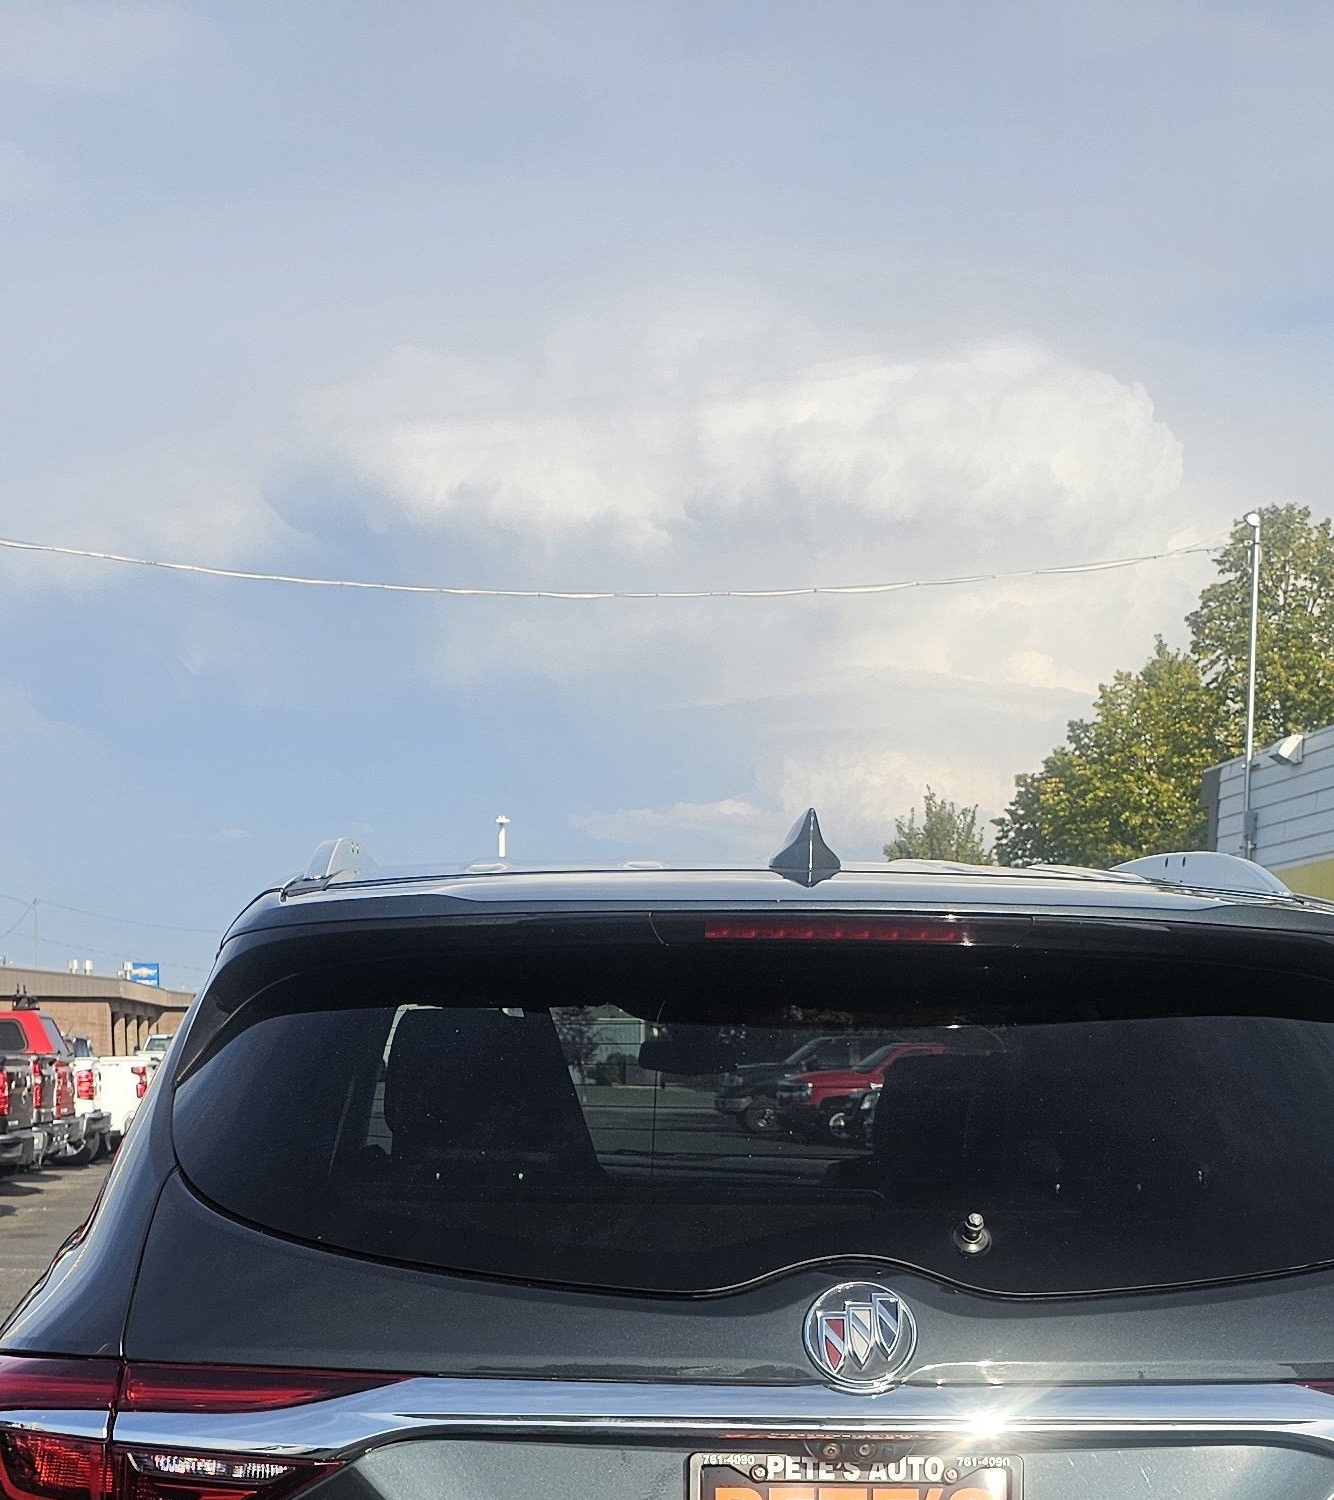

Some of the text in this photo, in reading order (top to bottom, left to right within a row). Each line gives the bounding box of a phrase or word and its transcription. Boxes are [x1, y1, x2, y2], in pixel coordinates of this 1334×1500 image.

[702, 1454, 756, 1466] 761-4090
[956, 1456, 1010, 1467] 761-4090
[767, 1455, 945, 1481] PETE'S AUTO
